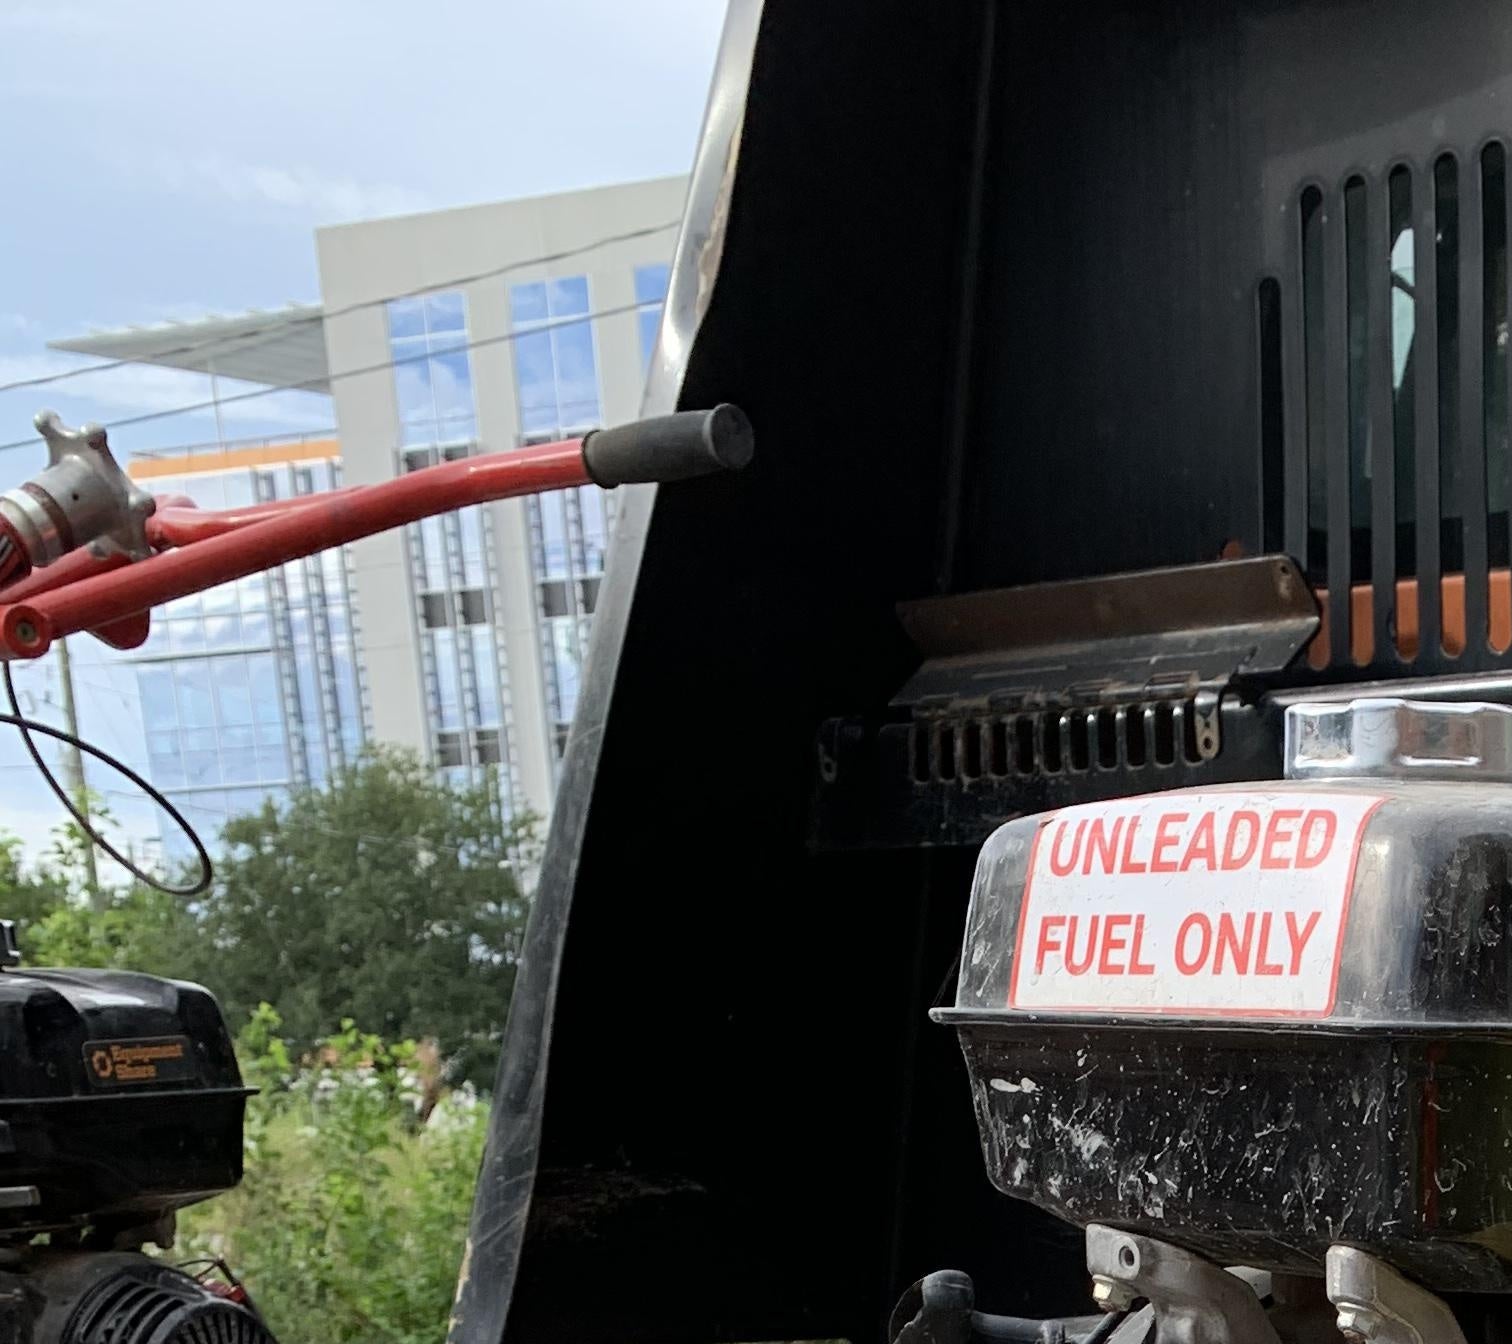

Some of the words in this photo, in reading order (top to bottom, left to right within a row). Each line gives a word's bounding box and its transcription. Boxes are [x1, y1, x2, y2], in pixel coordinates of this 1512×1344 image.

[1049, 808, 1338, 876] UNLEADED
[1034, 913, 1155, 976] FUEL
[1174, 910, 1322, 977] ONLY
